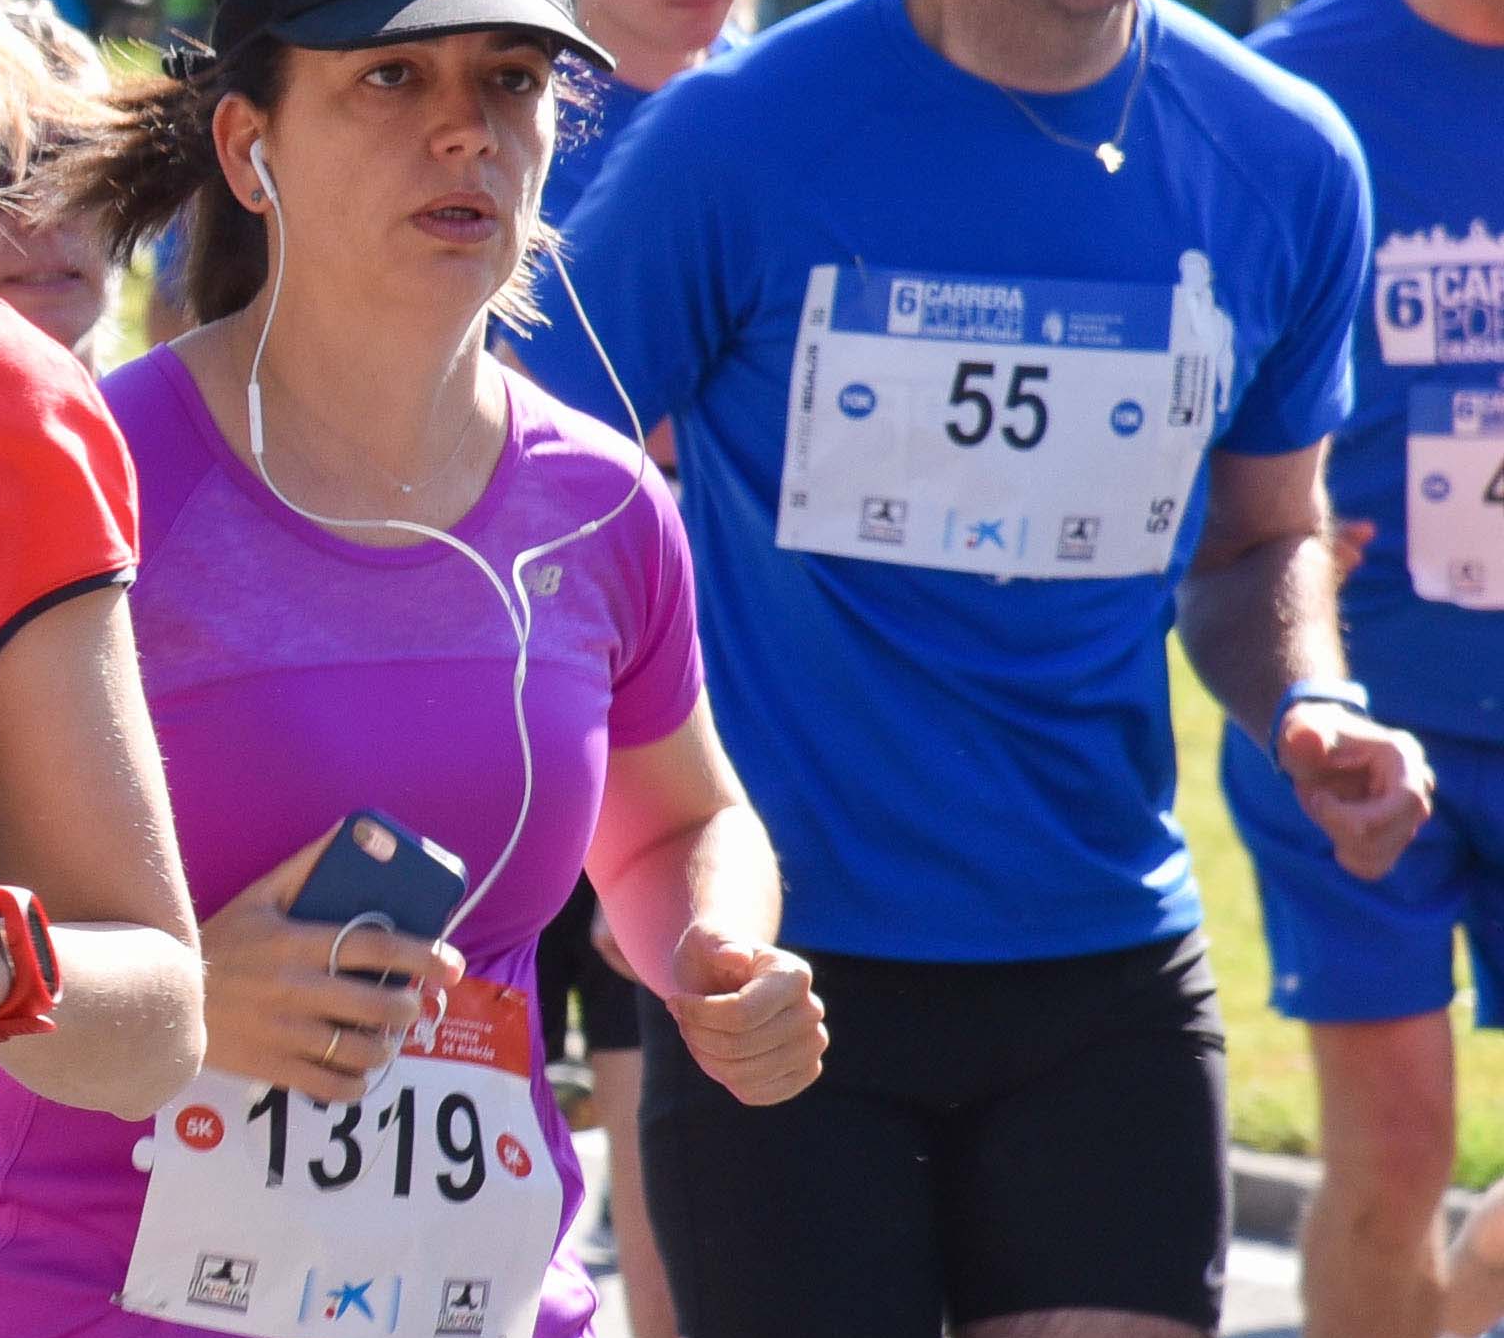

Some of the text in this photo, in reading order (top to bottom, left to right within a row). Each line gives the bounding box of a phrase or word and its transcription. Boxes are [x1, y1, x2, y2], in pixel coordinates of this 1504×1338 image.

[897, 286, 916, 315] 6
[1387, 280, 1424, 329] 6
[945, 361, 1049, 450] 55
[187, 1118, 214, 1138] 5K
[247, 1086, 486, 1201] 1319
